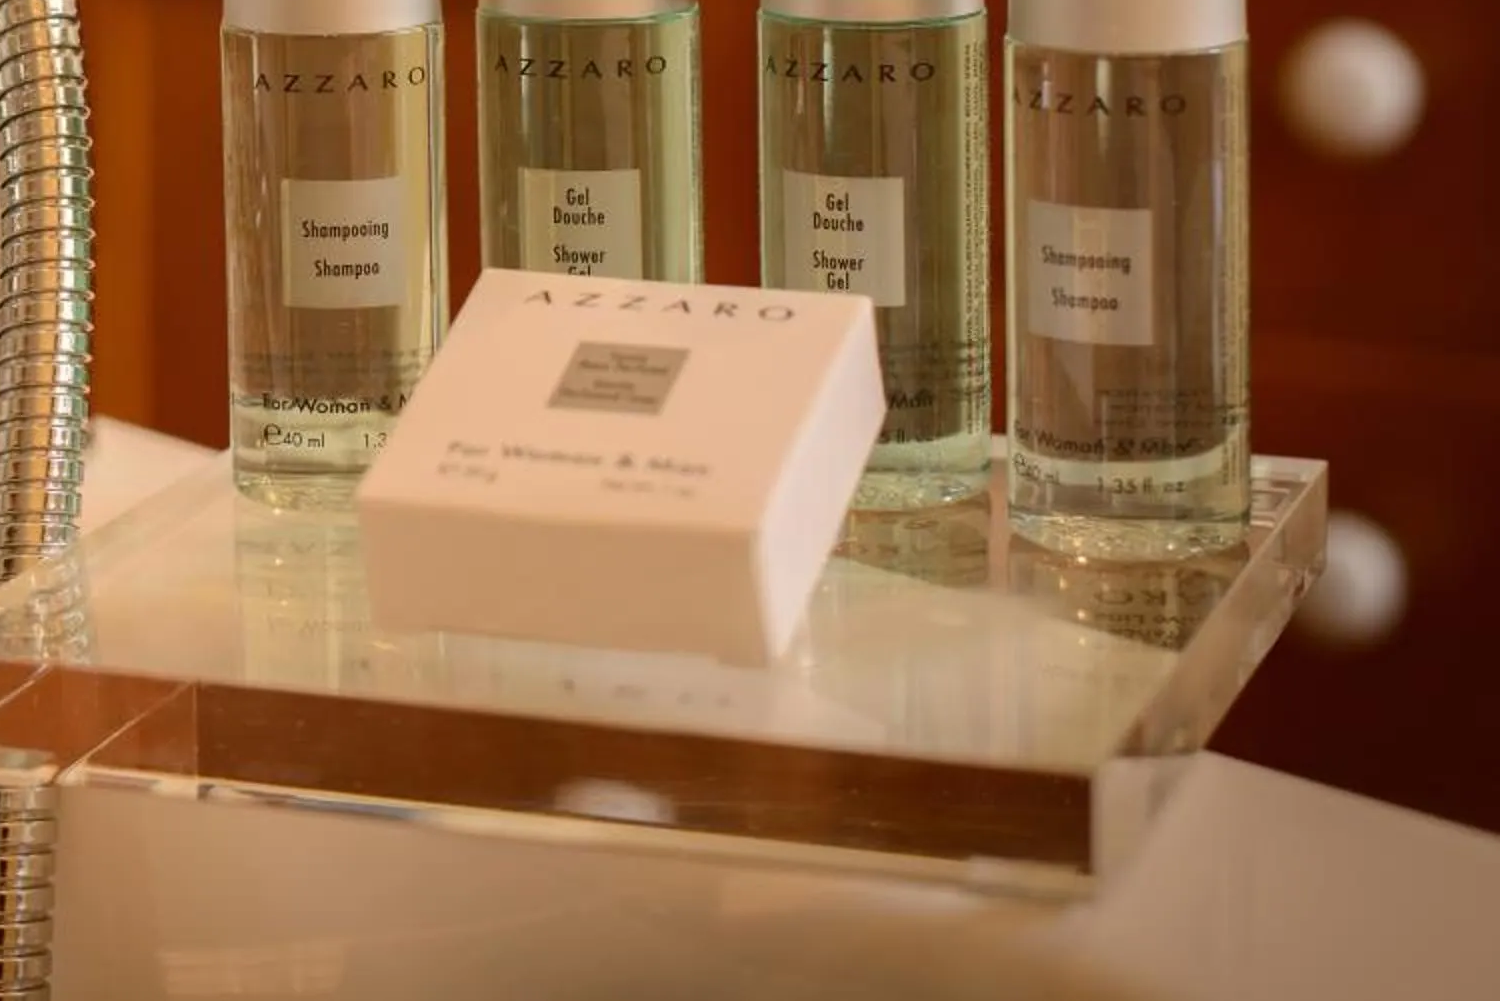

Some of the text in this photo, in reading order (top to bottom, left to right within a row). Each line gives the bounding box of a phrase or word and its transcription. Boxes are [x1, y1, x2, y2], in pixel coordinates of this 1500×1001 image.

[495, 55, 667, 79] AZZARO
[765, 55, 936, 83] AZZARO
[254, 66, 426, 94] AZZARO
[566, 187, 590, 206] Gel
[826, 192, 850, 212] Gel
[553, 206, 606, 225] Douche
[812, 212, 865, 232] Douche
[301, 219, 390, 242] Shampooing
[553, 244, 608, 264] Shower
[812, 249, 865, 271] Shower
[1041, 244, 1132, 276] Shampooing
[313, 257, 381, 280] Shampoo
[827, 271, 850, 291] Gel
[523, 289, 795, 322] AZZARO
[1051, 286, 1119, 313] Shampoo
[262, 392, 290, 411] For
[294, 396, 371, 415] Woman
[307, 432, 325, 448] ml
